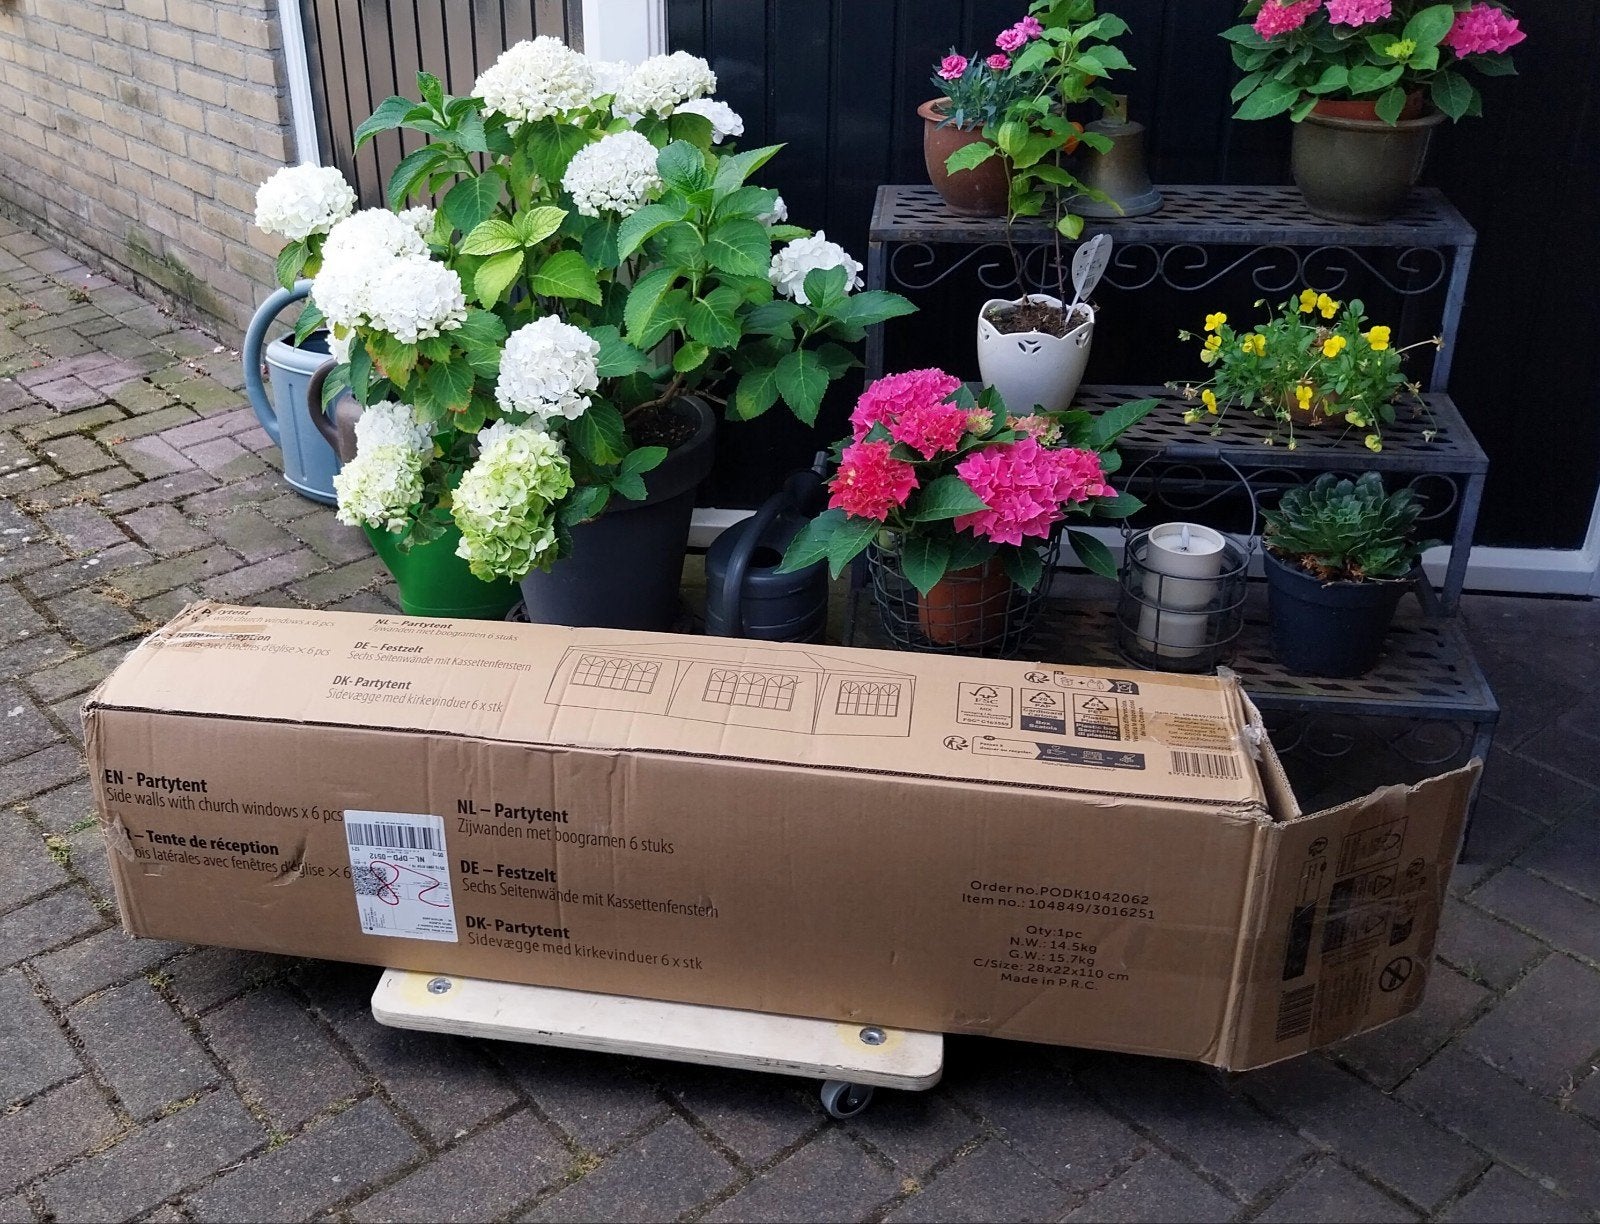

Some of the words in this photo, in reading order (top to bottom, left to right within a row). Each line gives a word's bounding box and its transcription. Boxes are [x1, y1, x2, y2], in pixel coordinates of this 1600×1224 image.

[265, 617, 302, 625] windows
[375, 618, 391, 626] NL
[401, 620, 453, 630] Partytent
[369, 625, 416, 634] Zijwanden
[417, 627, 435, 635] met
[437, 629, 487, 640] boogramen
[495, 634, 519, 642] stuks
[307, 647, 314, 655] 6
[314, 649, 331, 657] pcs
[354, 641, 370, 650] DE
[379, 643, 423, 654] Festzelt
[347, 651, 374, 661] Sechs
[434, 656, 451, 666] mit
[451, 657, 532, 672] Kassettenfenstern
[332, 675, 353, 686] DK-
[354, 677, 412, 690] Partytent
[326, 688, 382, 704] Sidevægge
[383, 691, 408, 703] med
[407, 692, 470, 710] kirkevinduer
[471, 700, 478, 710] 6
[487, 701, 504, 713] stk
[104, 768, 124, 784] EN
[136, 772, 208, 794] Partytent
[106, 787, 132, 803] Side
[134, 791, 166, 807] walls
[168, 795, 195, 811] with
[198, 796, 240, 814] church
[242, 801, 299, 819] windows
[311, 805, 321, 820] 6
[323, 807, 344, 824] pcs
[457, 799, 477, 815] NL
[494, 802, 569, 824] Partytent
[146, 829, 187, 847] Tente
[189, 833, 208, 849] de
[210, 836, 280, 856] réception
[457, 817, 523, 838] Zijwanden
[526, 824, 551, 841] met
[554, 826, 626, 849] boogramen
[629, 836, 639, 851] 6
[641, 838, 675, 855] stuks
[152, 849, 201, 865] latérales
[203, 855, 229, 869] avec
[231, 855, 278, 874] fenêtres
[342, 864, 351, 879] 6
[460, 859, 480, 875] DE
[496, 863, 557, 883] Festzelt
[970, 880, 1012, 893] Order
[462, 878, 497, 895] Sechs
[499, 881, 579, 904] Seitenwände
[582, 891, 604, 907] mit
[607, 893, 719, 919] Kassettenfenstern
[962, 893, 994, 905] Item
[1028, 899, 1155, 919] 104849/3016251
[465, 915, 492, 930] DK-
[495, 918, 570, 940] Partytent
[468, 931, 540, 954] Sidevægge
[542, 940, 572, 956] med
[574, 943, 658, 966] kirkevinduer
[660, 953, 670, 966] 6
[683, 956, 703, 970] stk
[1049, 940, 1098, 955] 14.5kg
[973, 958, 1024, 971] C/Size:
[1027, 963, 1104, 979] 28x22x110
[1107, 972, 1130, 981] cm
[1049, 953, 1096, 967] 15.7kg
[1000, 973, 1038, 985] Made
[1041, 976, 1055, 986] in
[1058, 978, 1099, 990] P.R.C.
